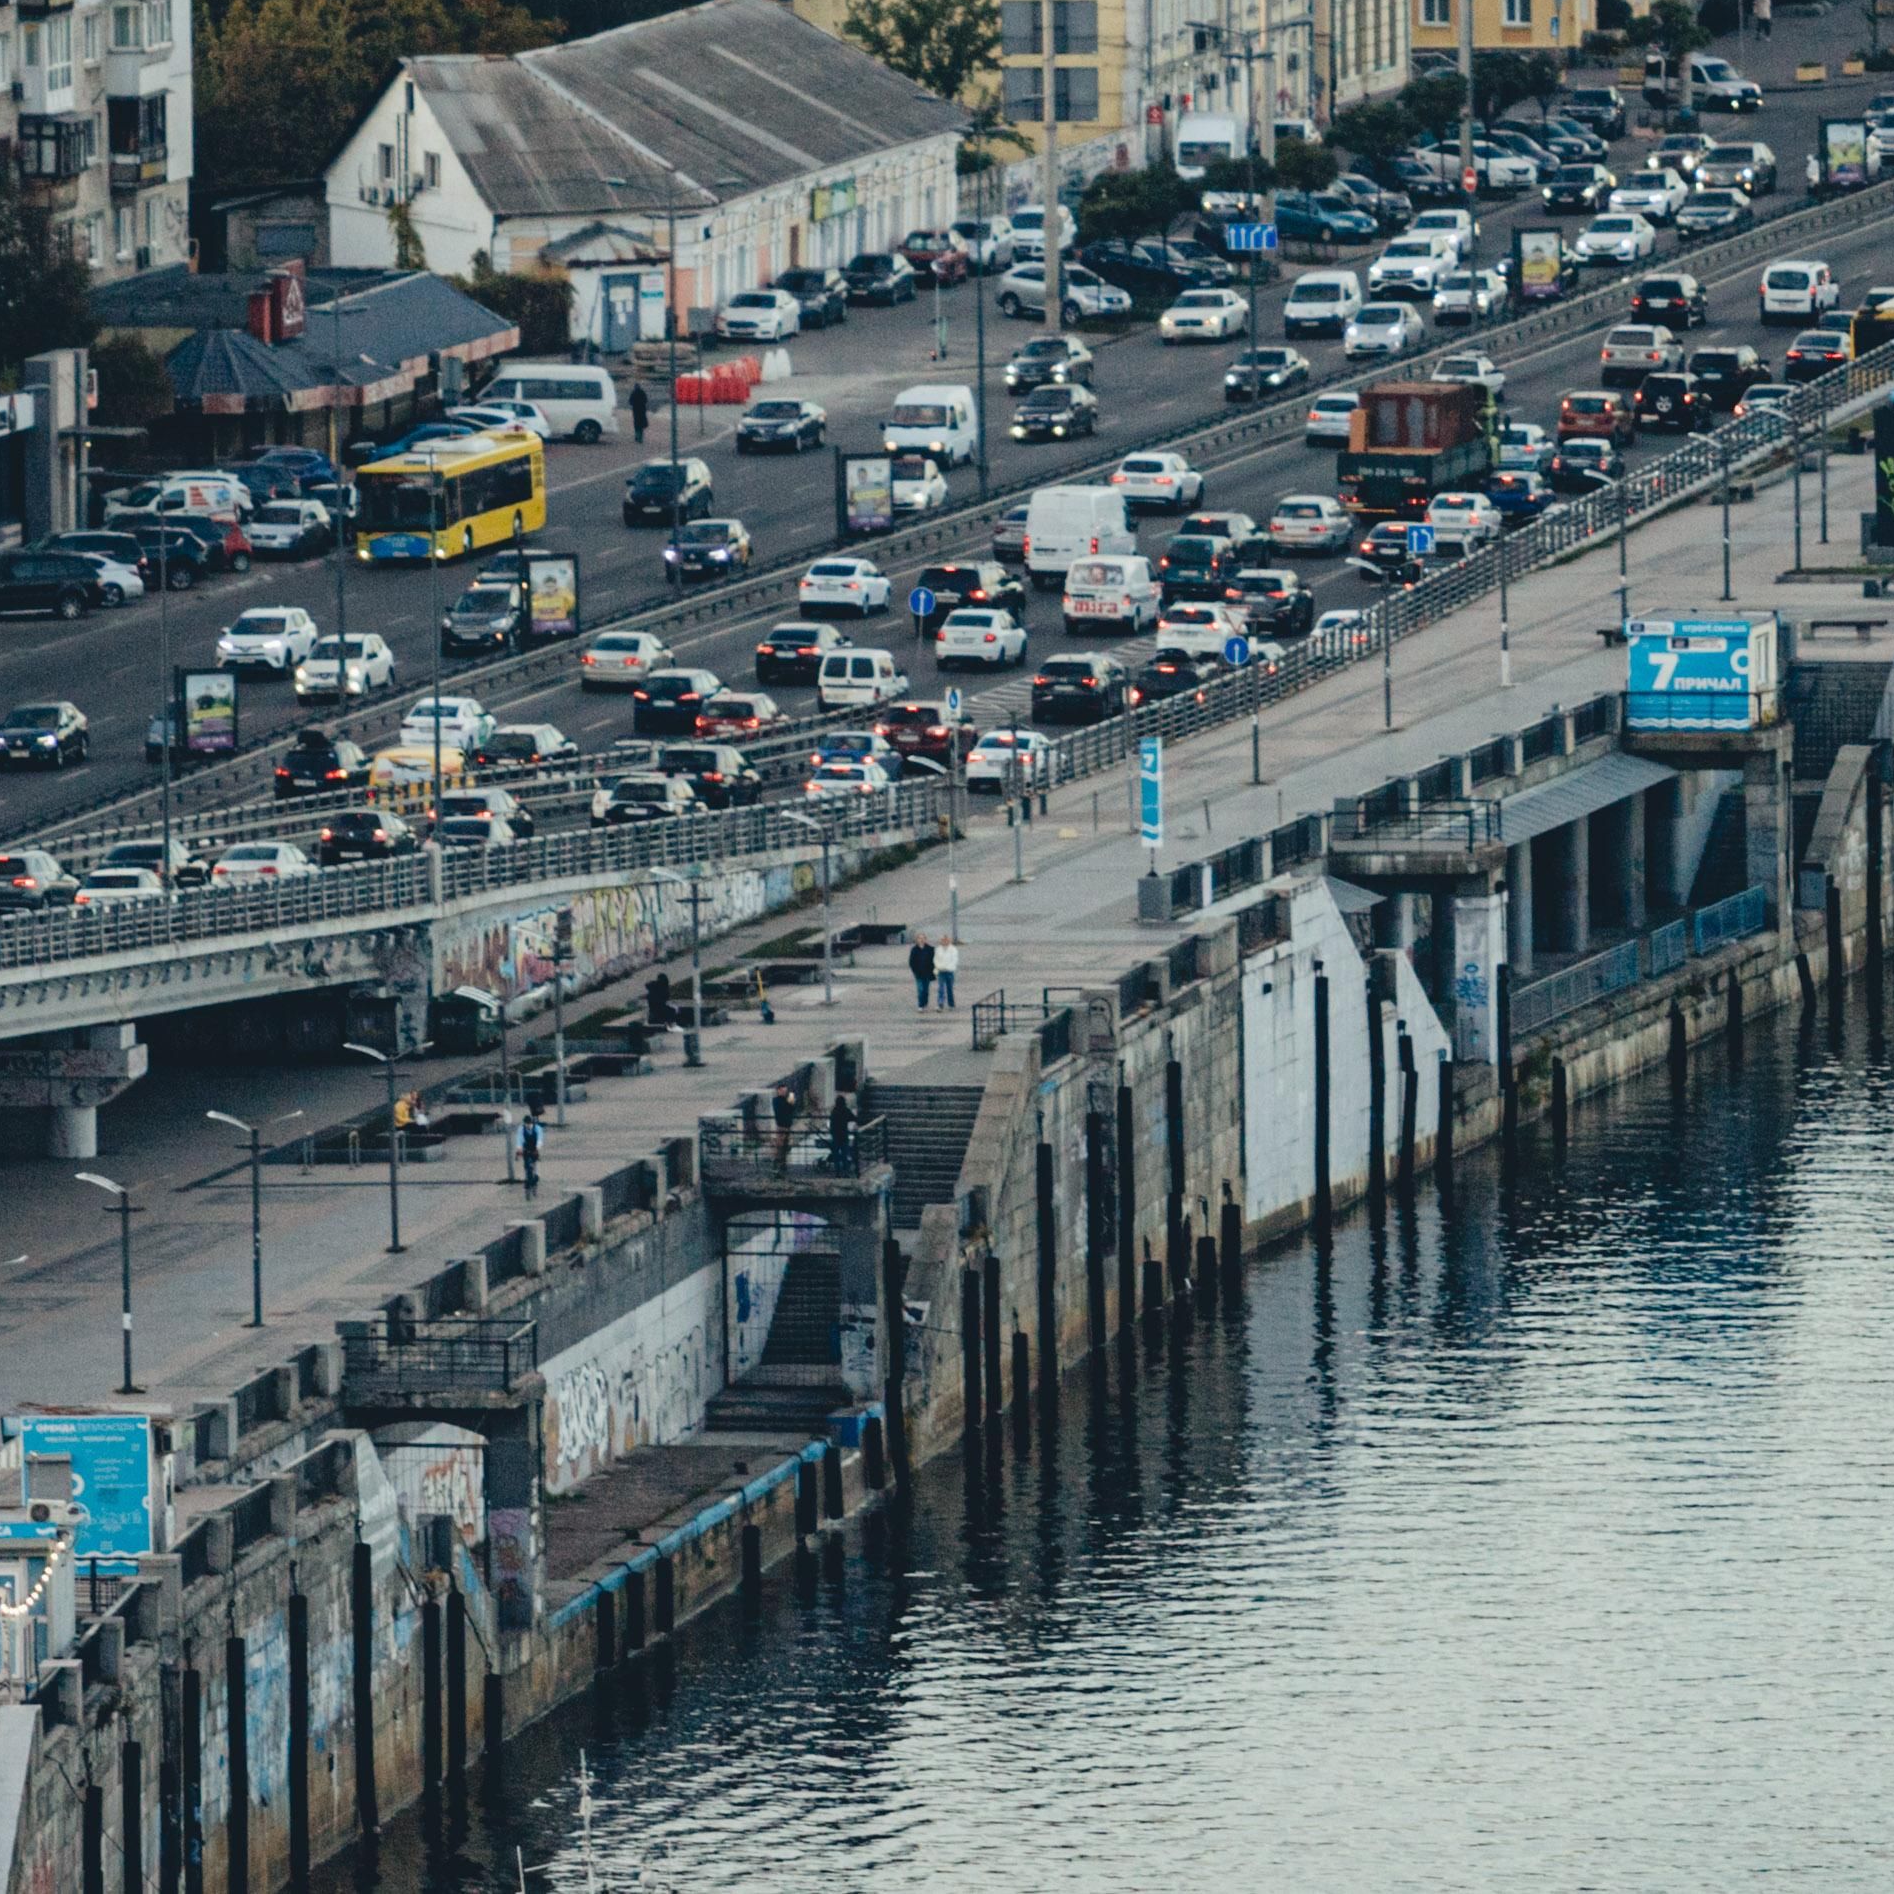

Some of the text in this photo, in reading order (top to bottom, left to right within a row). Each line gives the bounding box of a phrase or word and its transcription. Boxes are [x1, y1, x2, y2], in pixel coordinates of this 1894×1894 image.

[1648, 653, 1742, 691] 7 ПРИЧАЛ
[1143, 753, 1155, 768] 7
